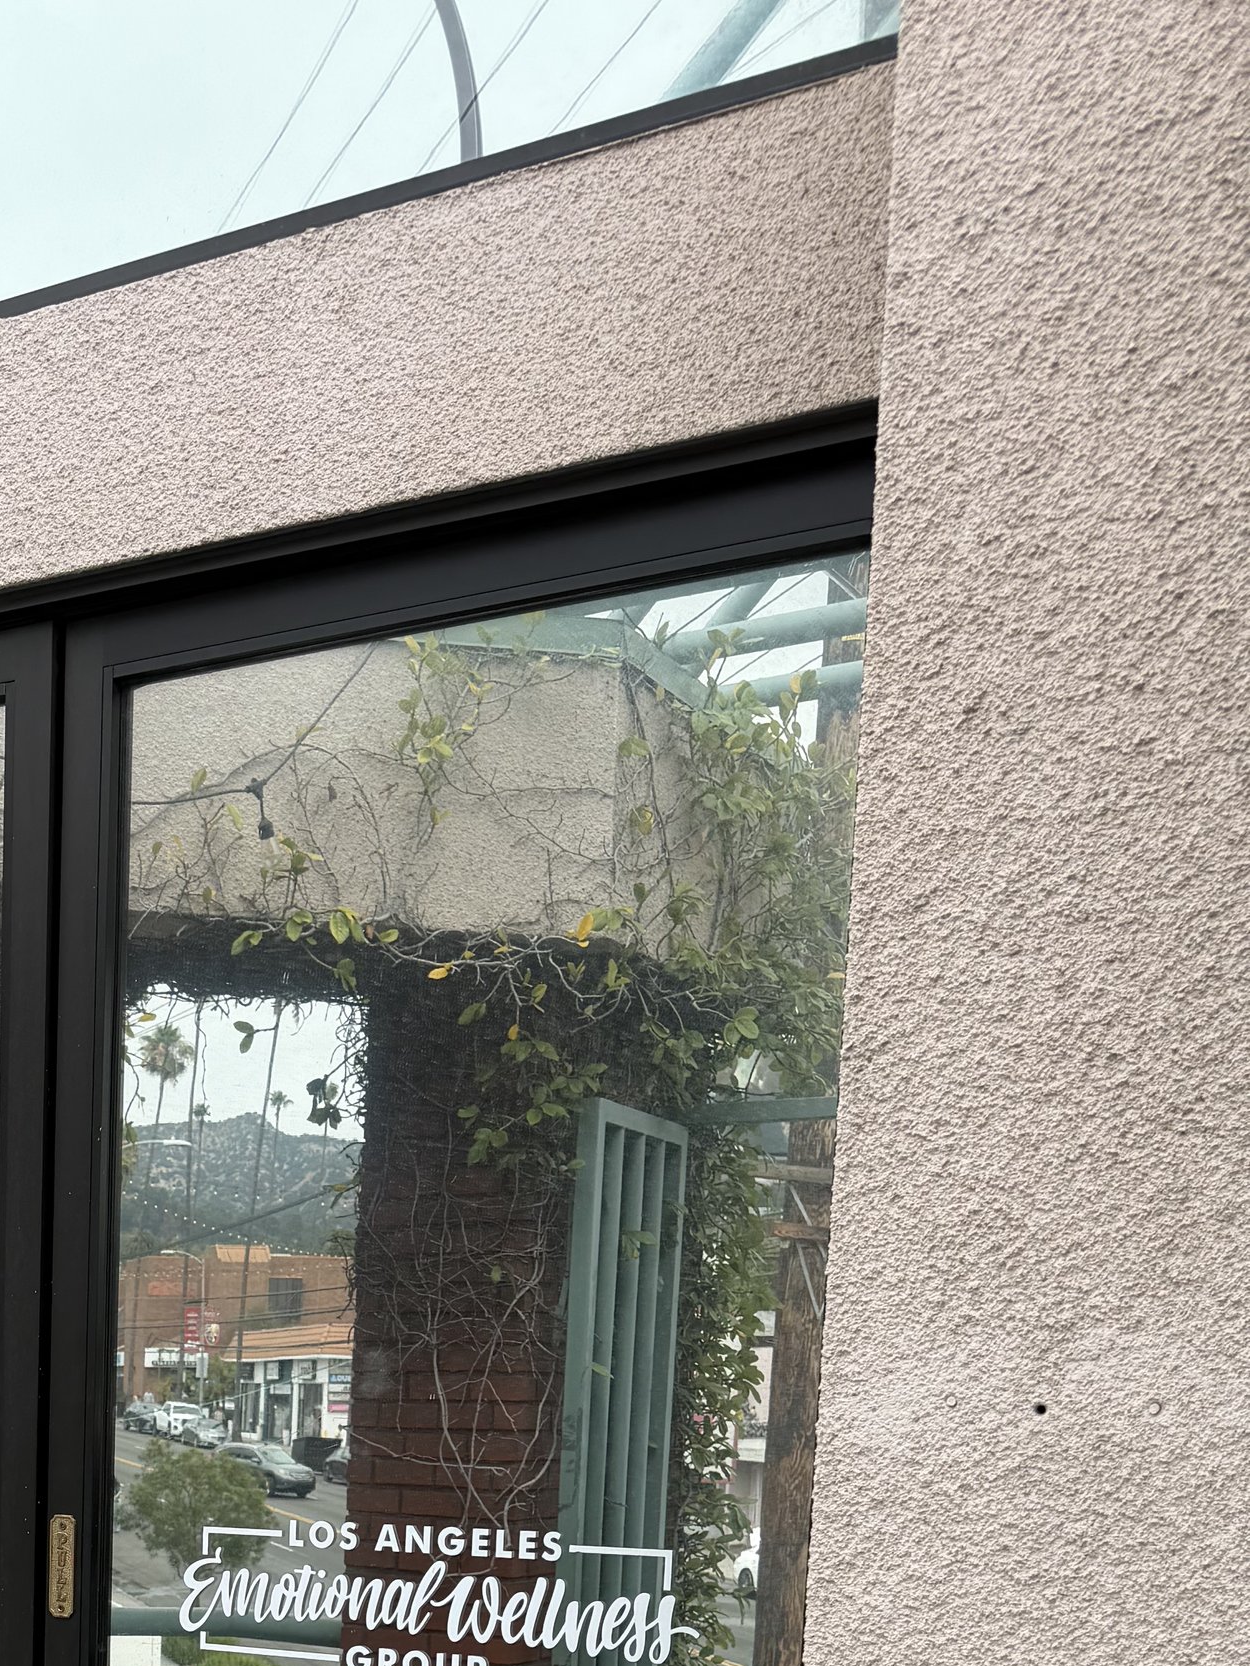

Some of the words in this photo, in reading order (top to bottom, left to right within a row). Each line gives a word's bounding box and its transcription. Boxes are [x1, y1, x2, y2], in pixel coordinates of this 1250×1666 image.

[288, 1519, 358, 1550] LOS
[375, 1523, 562, 1562] ANGELES
[179, 1546, 447, 1634] Emotional
[430, 1576, 700, 1665] Wellness
